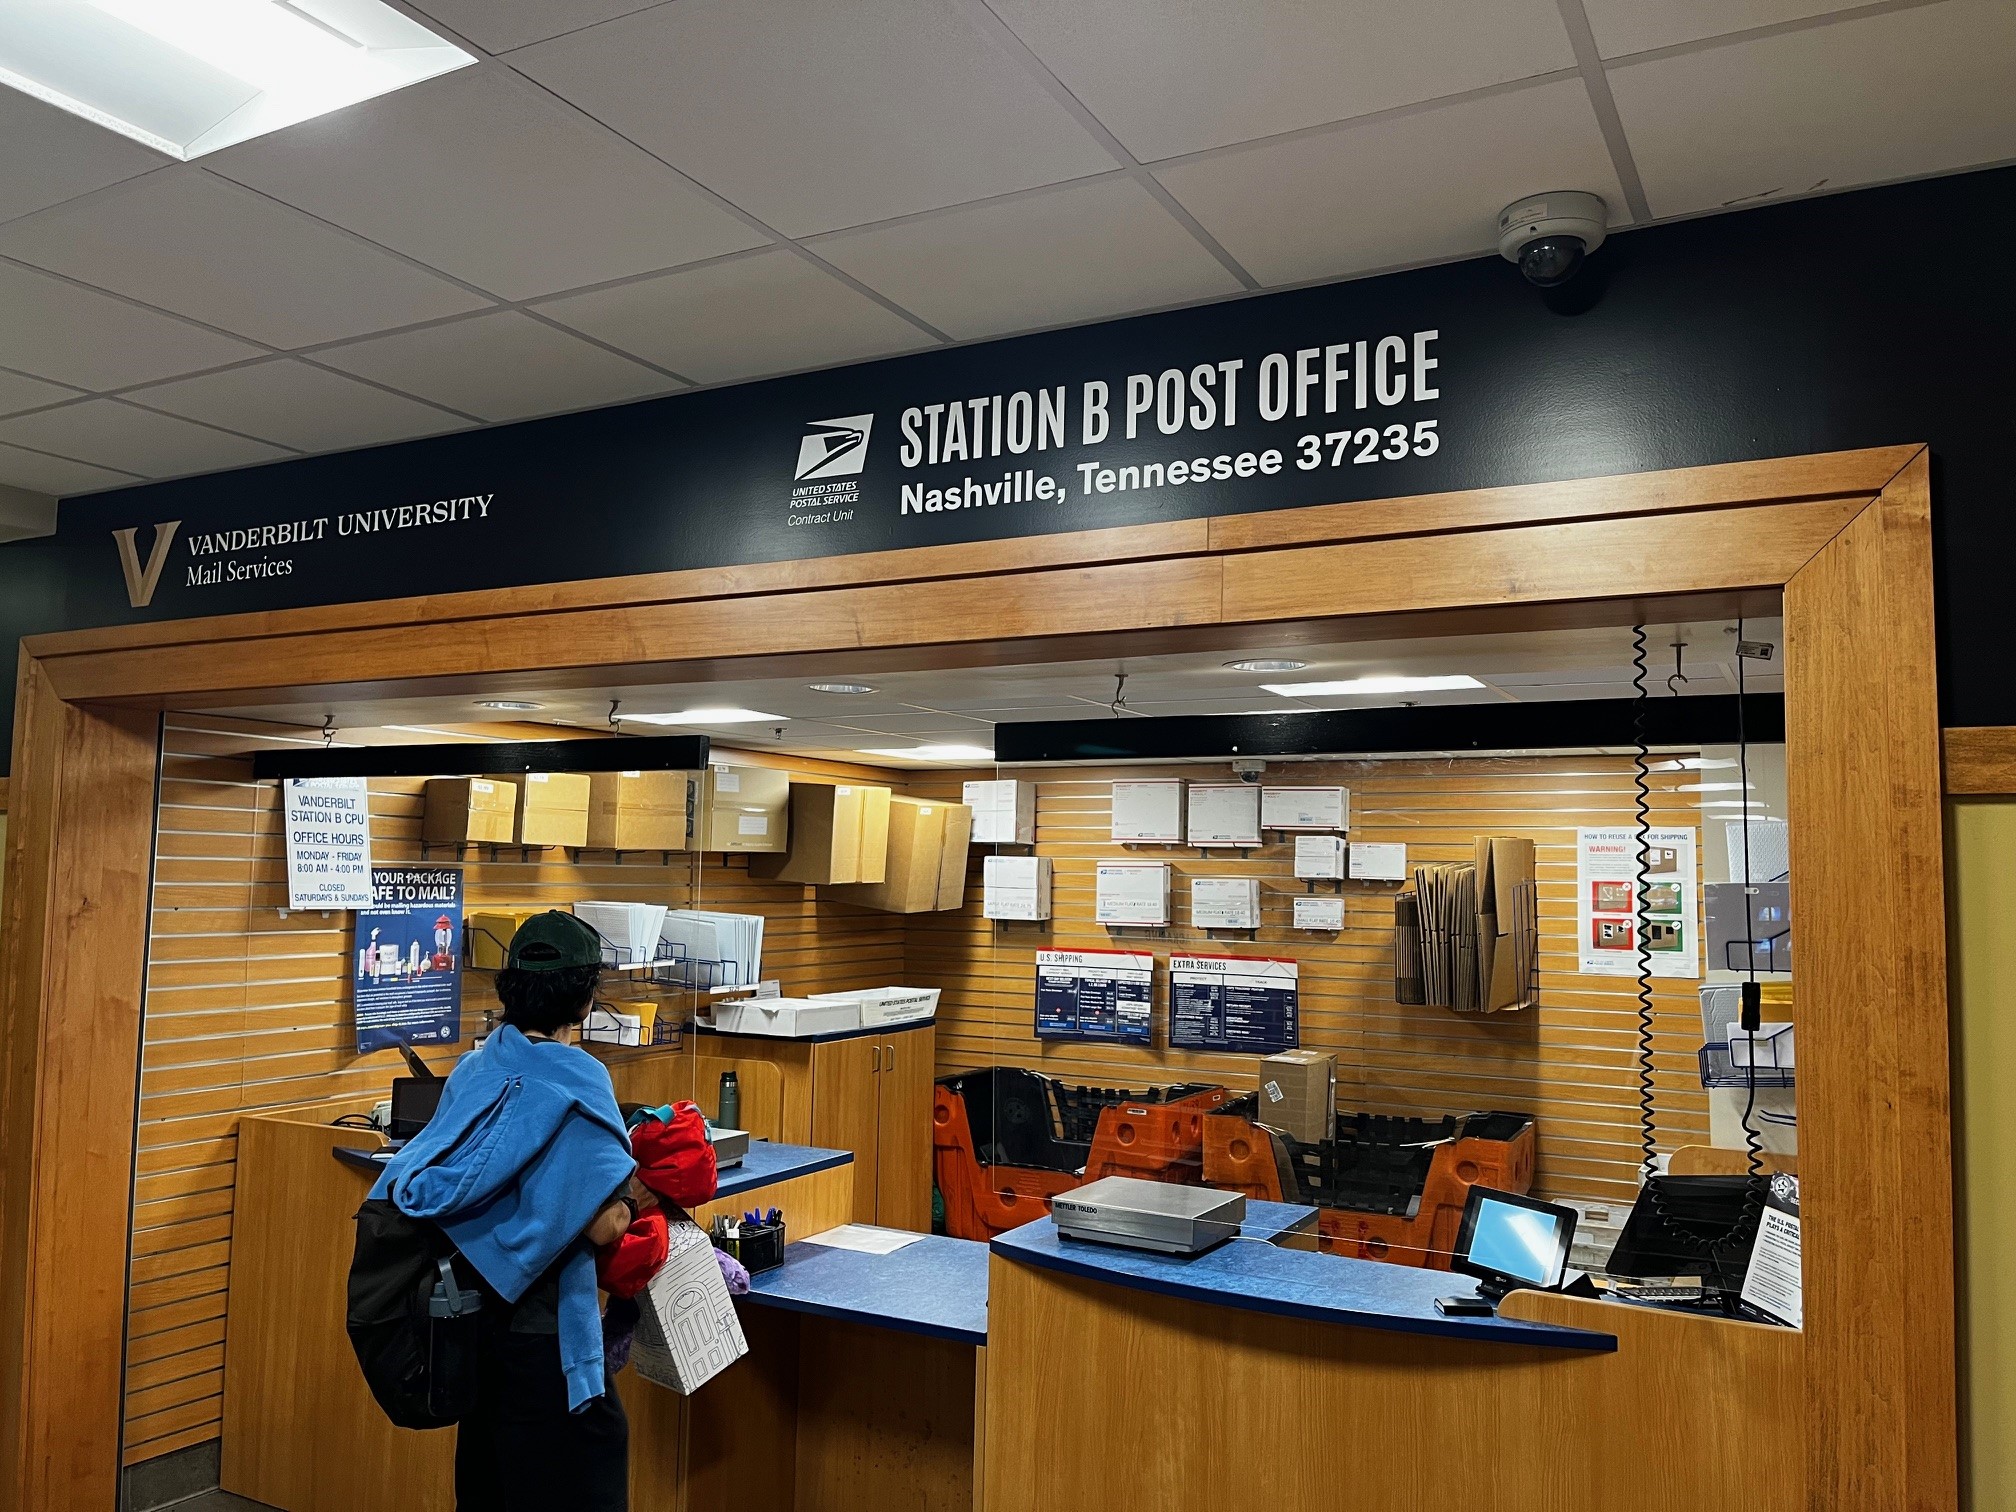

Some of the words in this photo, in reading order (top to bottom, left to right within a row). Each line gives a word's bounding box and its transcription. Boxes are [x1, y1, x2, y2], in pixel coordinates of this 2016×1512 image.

[900, 386, 1066, 469] STATION
[1082, 380, 1110, 446] B
[1126, 359, 1244, 440] POST
[1258, 329, 1441, 423] OFFICE
[900, 469, 1066, 515] Nashville,
[1077, 445, 1283, 497] Tennessee
[1295, 419, 1440, 471] 37235
[793, 485, 825, 496] UNITED
[826, 481, 857, 492] STATES
[790, 498, 821, 509] POSTAL
[823, 493, 859, 505] SERVICE
[788, 512, 830, 526] Contract
[833, 509, 854, 521] Unit
[188, 518, 328, 556] VANDERBILT
[338, 494, 494, 535] UNIVERSITY
[186, 561, 221, 587] Mail
[226, 556, 292, 582] Services
[299, 795, 355, 809] VANDERBILT
[291, 810, 331, 823] STATION
[335, 813, 341, 823] B
[345, 813, 364, 824] CPU
[293, 832, 328, 843] OFFICE
[332, 833, 364, 845] HOURS
[297, 851, 329, 860] MONDAY
[338, 852, 362, 861] FRIDAY
[297, 864, 313, 873] 8:00
[316, 864, 328, 873] AM
[335, 864, 350, 873] 4:00
[353, 865, 363, 873] PM
[373, 872, 404, 884] YOUR
[407, 872, 456, 884] PACKAGE
[319, 884, 345, 892] CLOSED
[372, 886, 393, 900] AFE
[397, 886, 415, 900] TO
[419, 886, 456, 900] MAIL?
[1040, 953, 1052, 961] U.S.
[1054, 954, 1082, 963] SHIPPING
[1174, 960, 1194, 969] EXTRA
[1197, 960, 1227, 971] SERVICES
[1055, 1202, 1076, 1210] METTLER
[1078, 1205, 1097, 1214] TOLEDO
[1766, 1222, 1779, 1231] PLAYS
